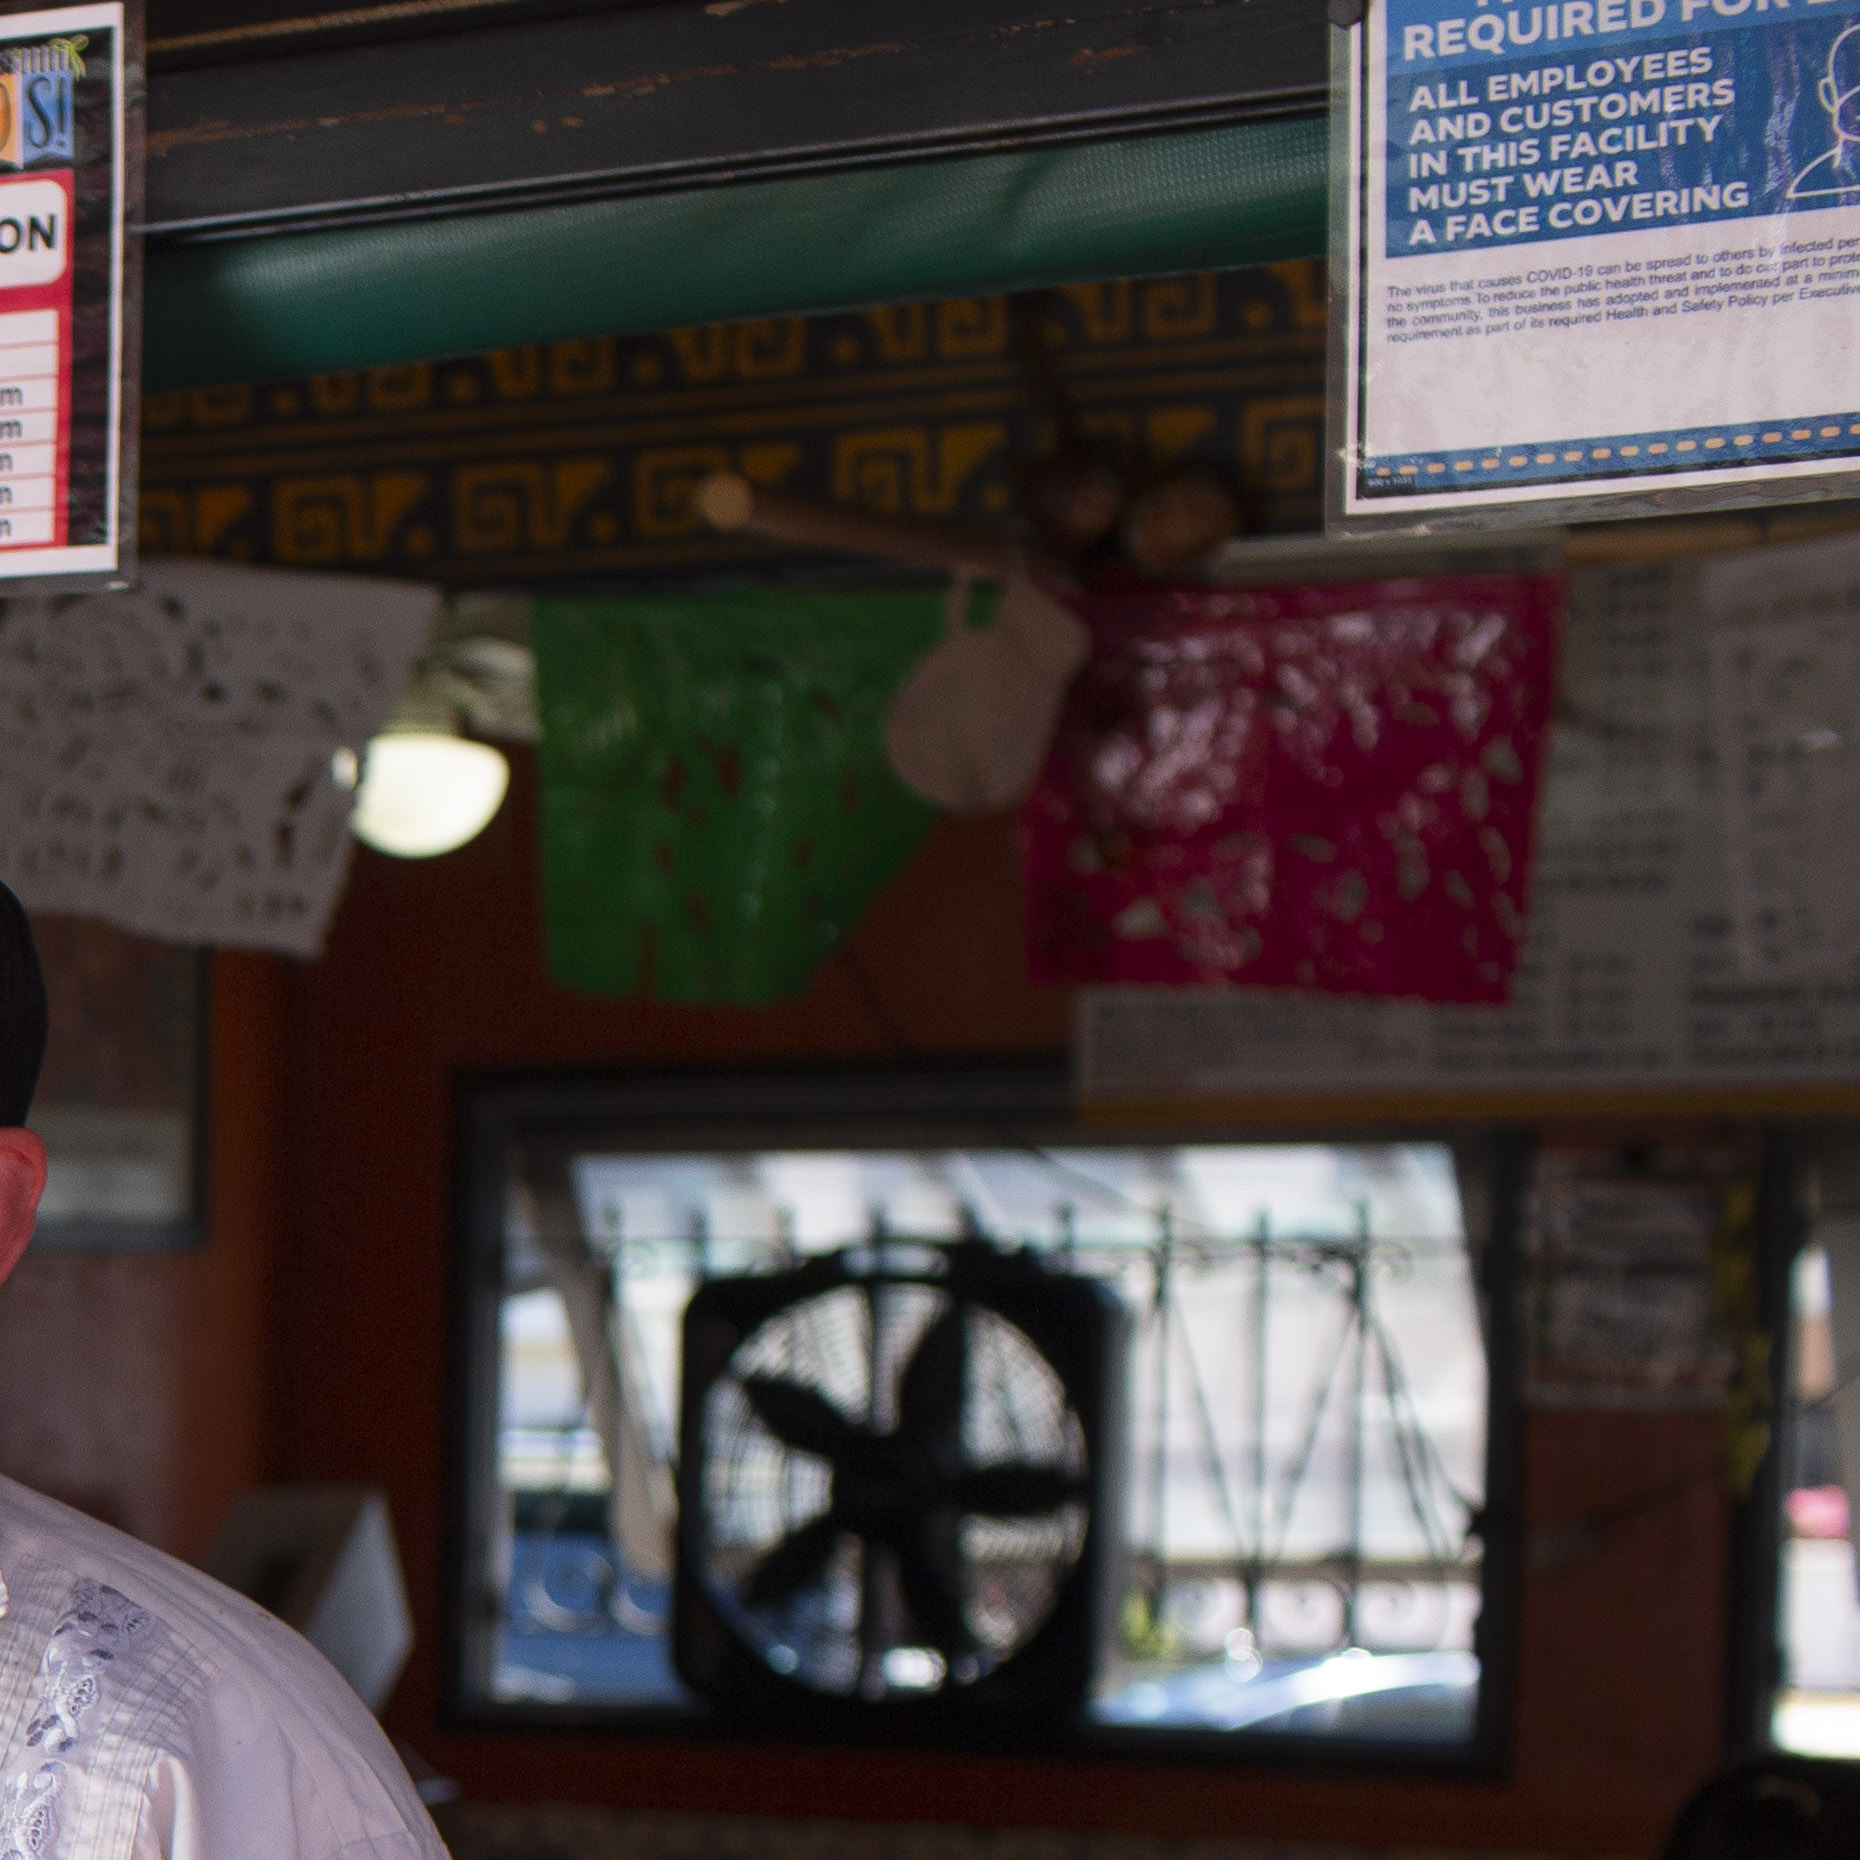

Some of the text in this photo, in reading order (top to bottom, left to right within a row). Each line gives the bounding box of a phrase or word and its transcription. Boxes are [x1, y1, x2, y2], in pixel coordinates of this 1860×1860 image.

[1403, 0, 1668, 61] REQUIRED
[1409, 46, 1713, 113] ALL EMPLOYEES
[1409, 78, 1736, 146] AND CUSTOMERS
[1409, 114, 1723, 180] IN THIS FACILITY
[1409, 160, 1639, 213] MUST WEAR
[1409, 180, 1750, 246] A FACE COVERING
[1387, 286, 1412, 298] The
[1416, 284, 1446, 296] virus
[1450, 279, 1473, 291] that
[1478, 276, 1523, 289] causes
[1597, 262, 1620, 275] can
[1625, 260, 1641, 272] be
[1646, 254, 1691, 271] spread
[1696, 253, 1708, 265] to
[1712, 247, 1755, 262] others
[1387, 302, 1403, 313] no
[1475, 292, 1489, 304] To
[1493, 288, 1536, 302] reduce
[1540, 284, 1560, 297] the
[1564, 280, 1602, 295] public
[1605, 276, 1646, 290] health
[1650, 271, 1687, 285] threat
[1691, 268, 1715, 281] and
[1719, 266, 1732, 278] to
[1735, 263, 1753, 276] do
[1783, 258, 1809, 274] part
[1813, 255, 1825, 268] to
[1387, 315, 1407, 328] the
[1489, 304, 1511, 317] this
[1515, 299, 1572, 315] business
[1577, 295, 1601, 308] has
[1606, 290, 1659, 307] adopted
[1663, 286, 1689, 299] and
[1694, 277, 1780, 296] implemented
[1785, 274, 1799, 287] at
[1387, 323, 1463, 344] requirement
[1466, 325, 1482, 336] as
[1485, 321, 1510, 336] part
[1548, 310, 1602, 327] required
[1606, 306, 1648, 322] Health
[1652, 303, 1678, 316] and
[1681, 296, 1724, 313] Safety
[1728, 292, 1768, 308] Policy
[1772, 291, 1795, 304] per
